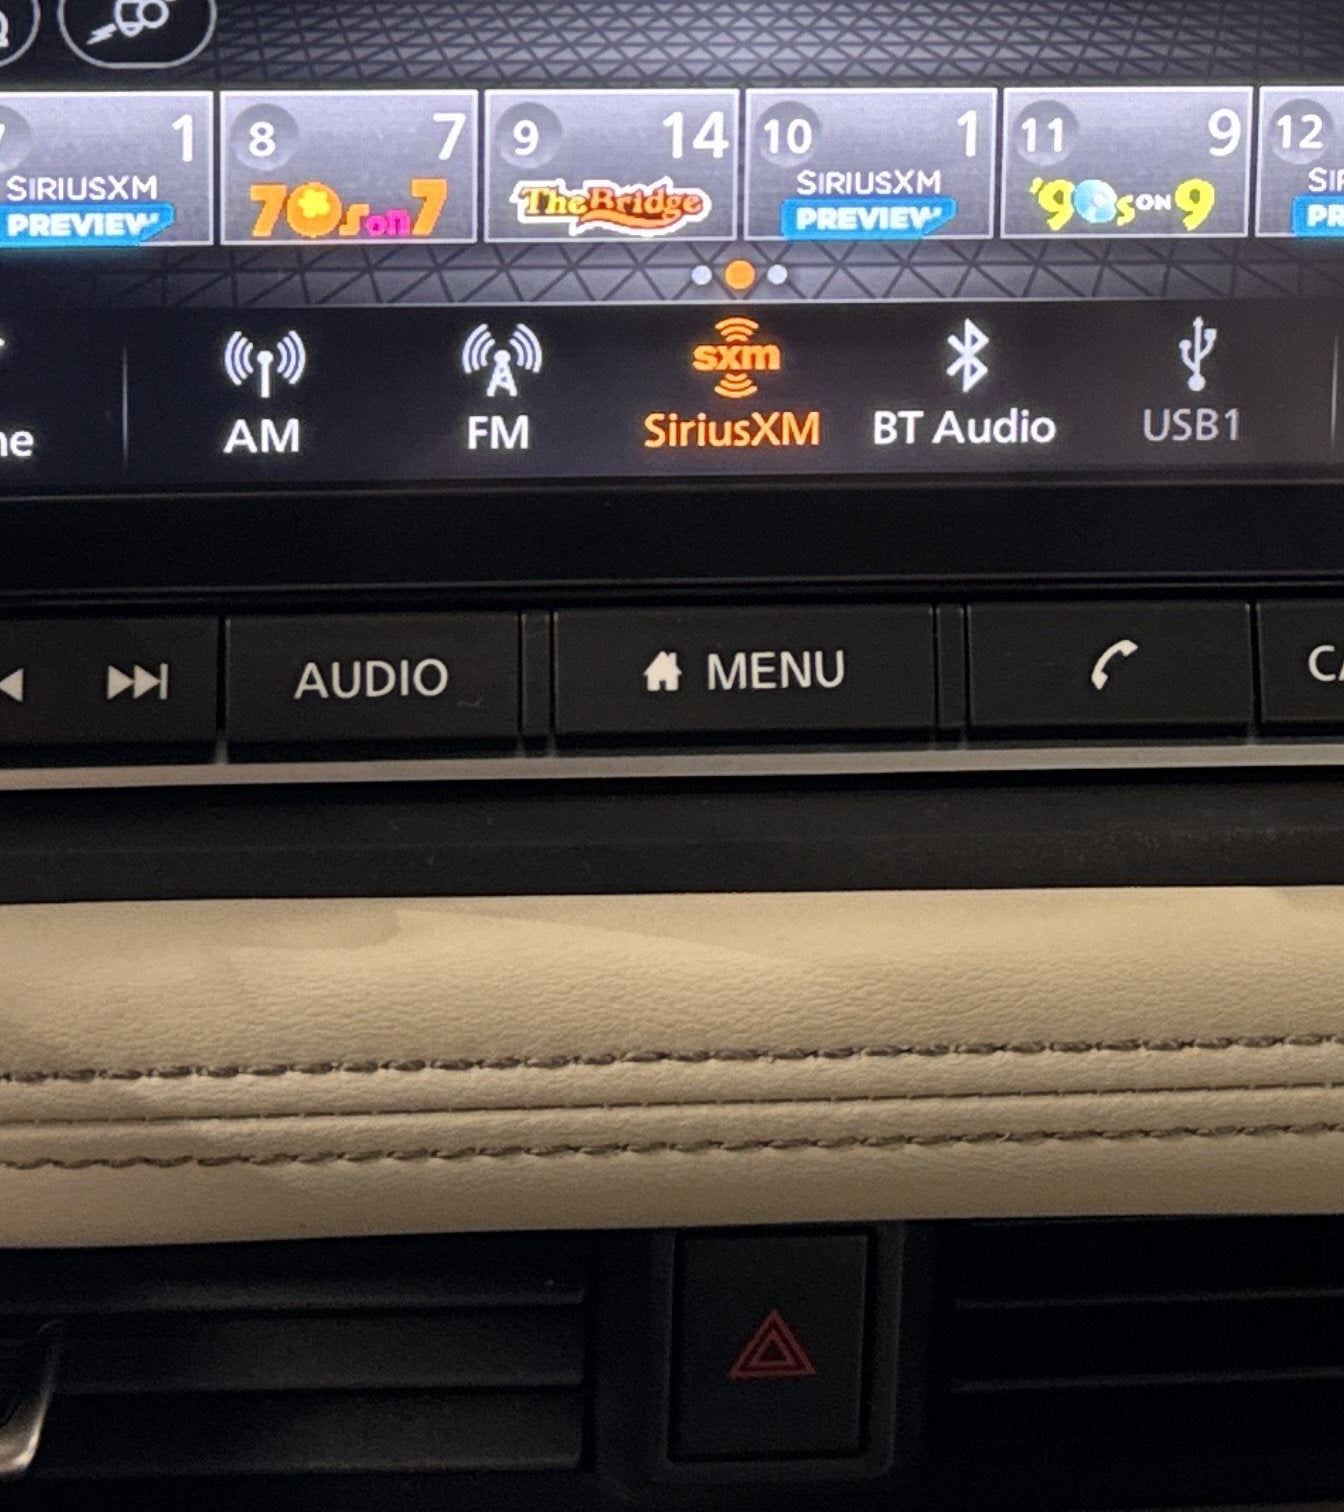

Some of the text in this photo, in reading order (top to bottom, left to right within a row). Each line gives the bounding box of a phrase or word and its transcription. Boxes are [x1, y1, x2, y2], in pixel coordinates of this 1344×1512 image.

[171, 112, 194, 162] 1
[247, 120, 277, 158] 8
[432, 112, 467, 161] 7
[512, 119, 540, 157] 9
[661, 110, 730, 160] 14
[762, 117, 813, 156] 10
[957, 110, 979, 158] 1
[1020, 117, 1065, 153] 11
[1207, 107, 1242, 158] 9
[1275, 113, 1325, 150] 12
[6, 174, 158, 201] SIRIUSXM
[796, 169, 941, 196] SIRIUSXM
[796, 206, 942, 231] PREVIEW
[1135, 192, 1172, 212] ON
[1174, 178, 1216, 230] 9
[7, 212, 159, 238] PREVIEW
[692, 344, 781, 371] sxm
[223, 418, 300, 454] AM
[468, 414, 529, 450] FM
[644, 411, 820, 448] SiriusXM
[873, 407, 1057, 445] BT Audio
[1143, 408, 1238, 442] USB1
[294, 658, 448, 699] AUDIO
[708, 650, 844, 690] MENU
